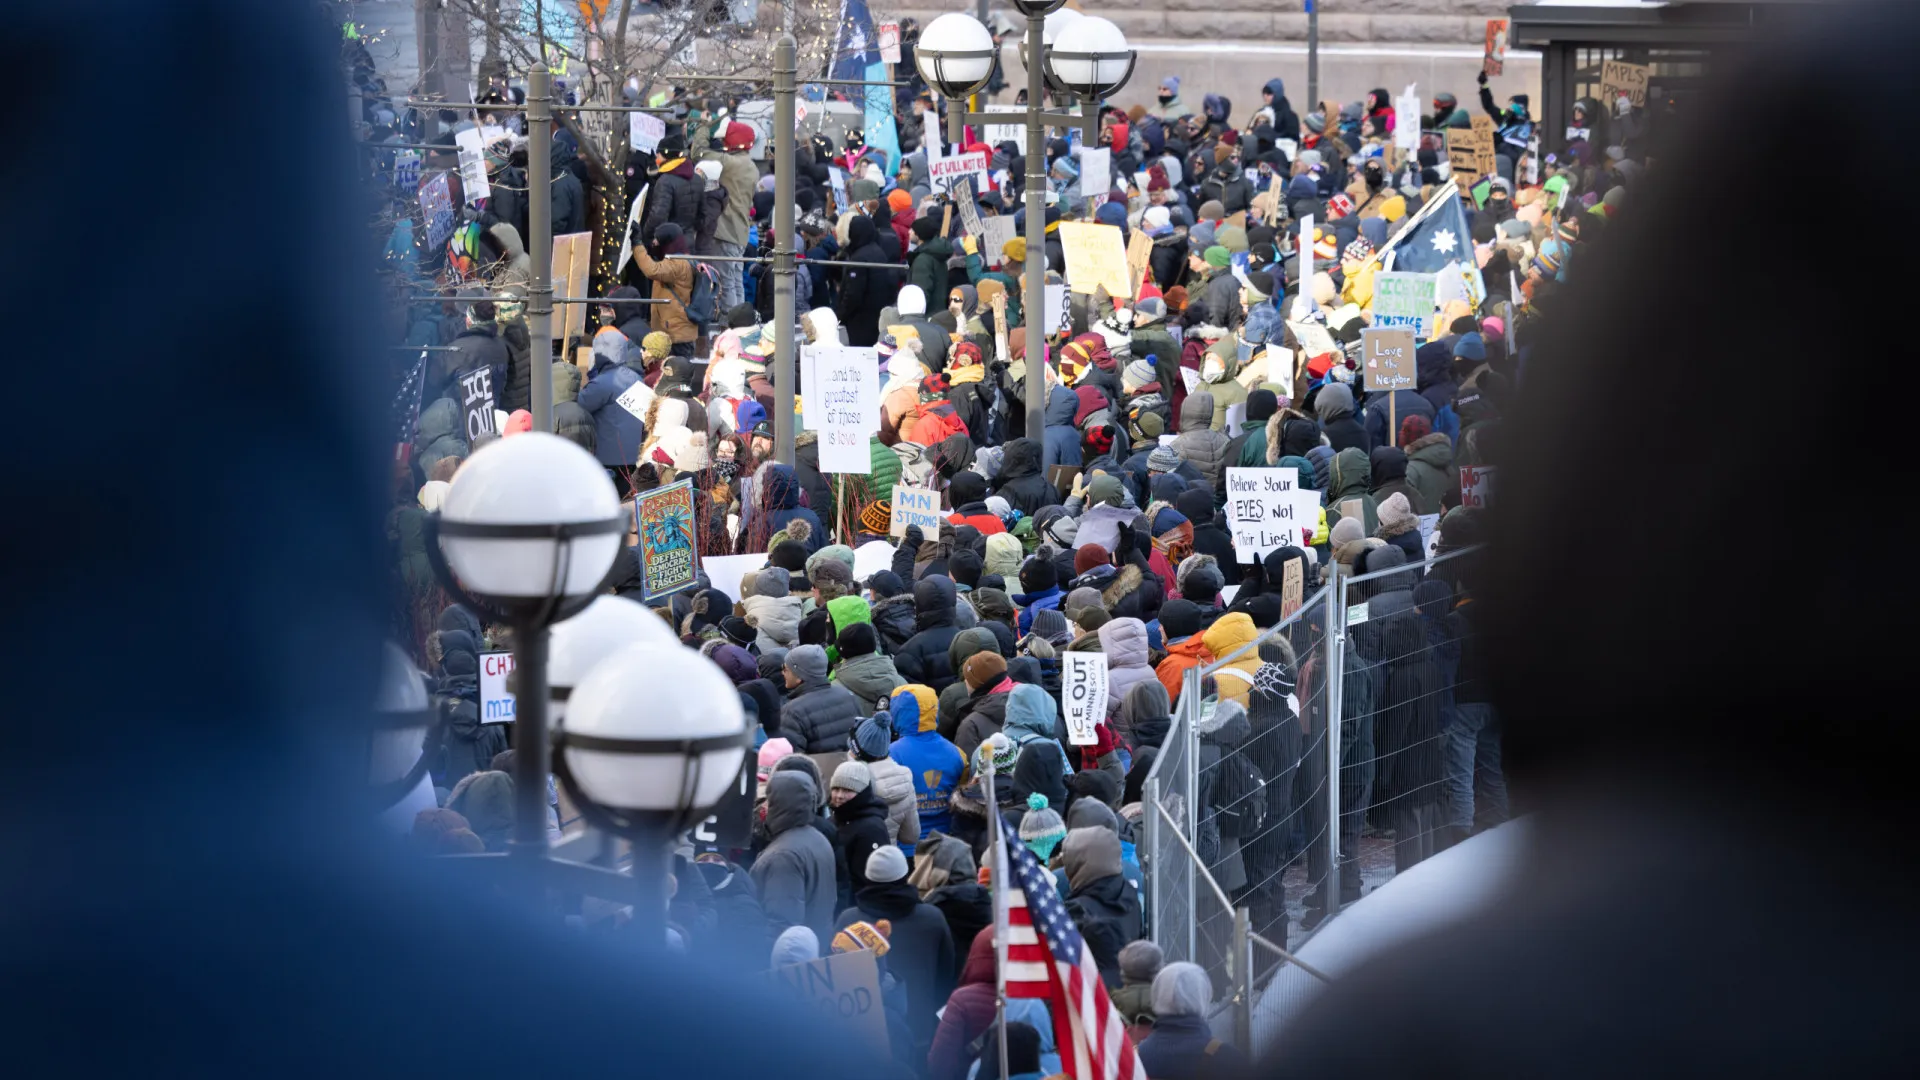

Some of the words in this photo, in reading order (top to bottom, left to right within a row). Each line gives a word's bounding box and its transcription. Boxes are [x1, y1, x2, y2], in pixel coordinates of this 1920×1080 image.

[1605, 63, 1644, 84] MPLS
[930, 162, 944, 176] WE
[945, 160, 963, 173] WILL
[963, 159, 975, 172] NOT
[1376, 339, 1402, 357] Love
[463, 368, 492, 406] ICE
[824, 384, 858, 408] greatest
[468, 400, 494, 440] OUT
[827, 408, 836, 423] of
[838, 430, 856, 445] love
[1230, 473, 1257, 492] Believe
[1264, 475, 1292, 492] Your
[643, 487, 689, 516] RESIST
[896, 509, 937, 528] STRONG
[1260, 528, 1293, 547] Lies!
[648, 554, 691, 574] DEMOCRACY
[651, 550, 686, 566] DEFEND
[652, 569, 690, 589] FASCISM
[659, 565, 684, 579] FIGHT
[1286, 561, 1299, 581] ICE
[1284, 580, 1300, 600] OUT
[1073, 658, 1087, 701] OUT
[1085, 659, 1097, 721] MINNESOTA
[1072, 707, 1085, 738] ICE
[1086, 723, 1093, 738] OF
